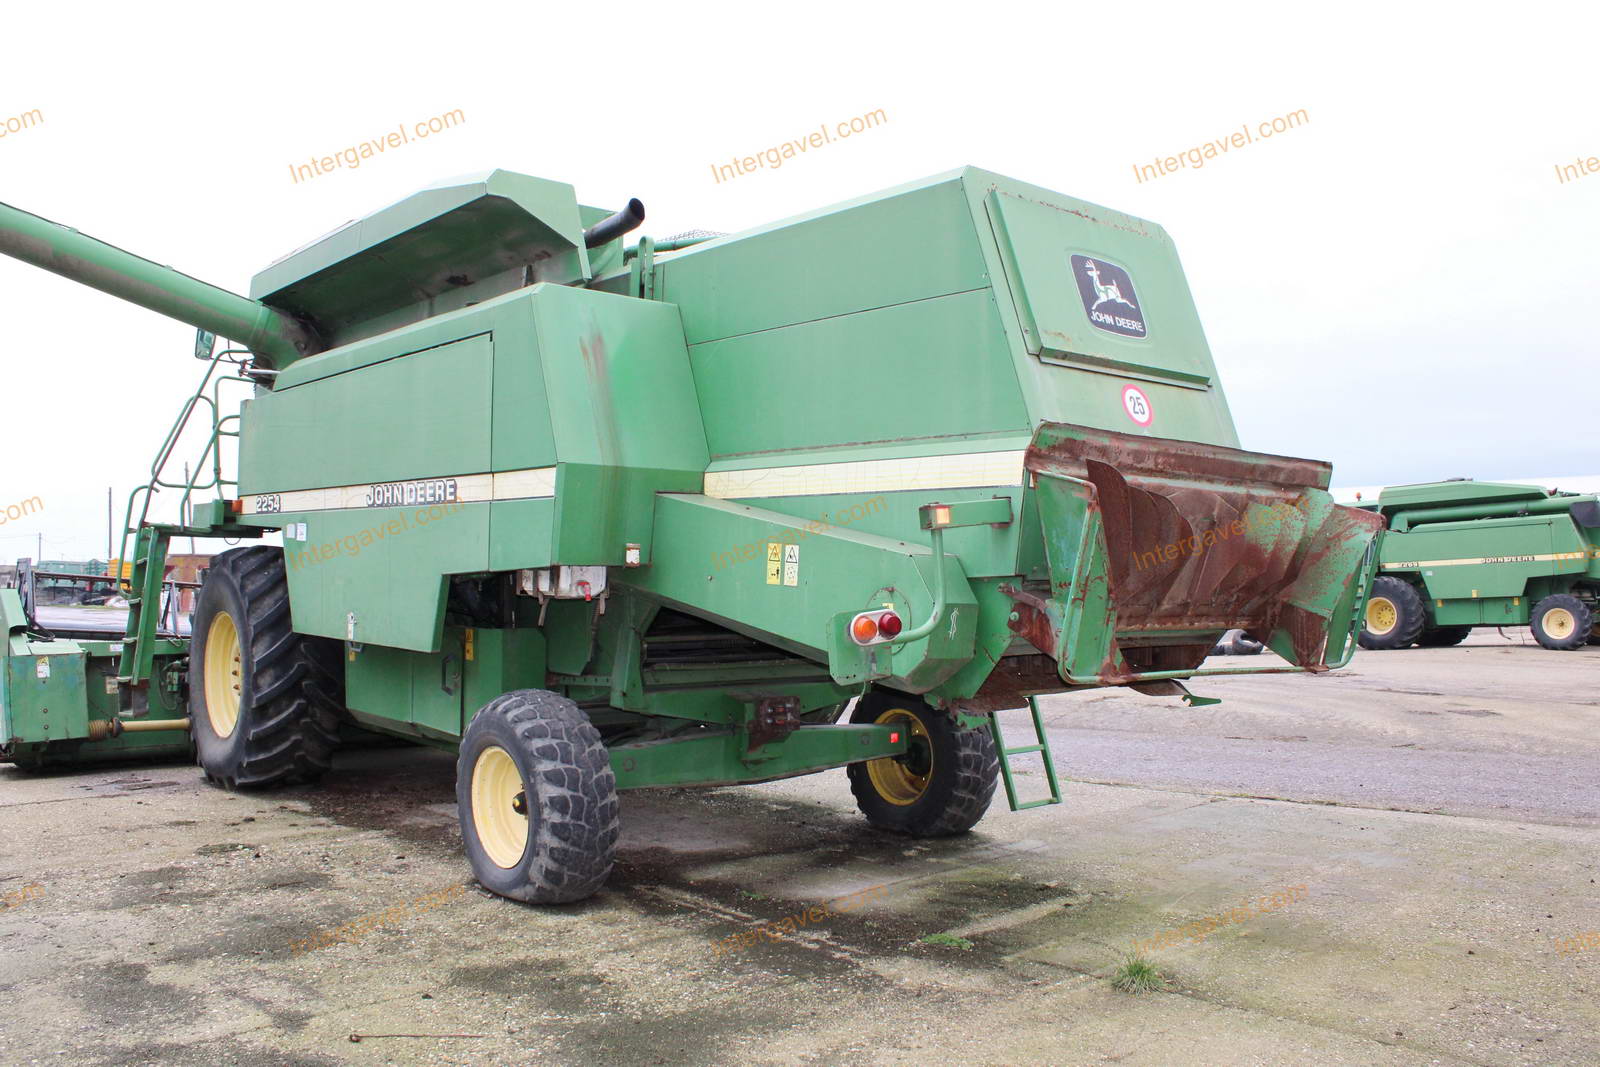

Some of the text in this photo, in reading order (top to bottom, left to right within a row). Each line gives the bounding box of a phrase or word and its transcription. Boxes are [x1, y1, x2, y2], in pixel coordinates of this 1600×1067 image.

[1091, 311, 1145, 332] JOHN DEERE
[1129, 395, 1146, 415] 25
[256, 479, 458, 514] 2254 JOHN DEERE
